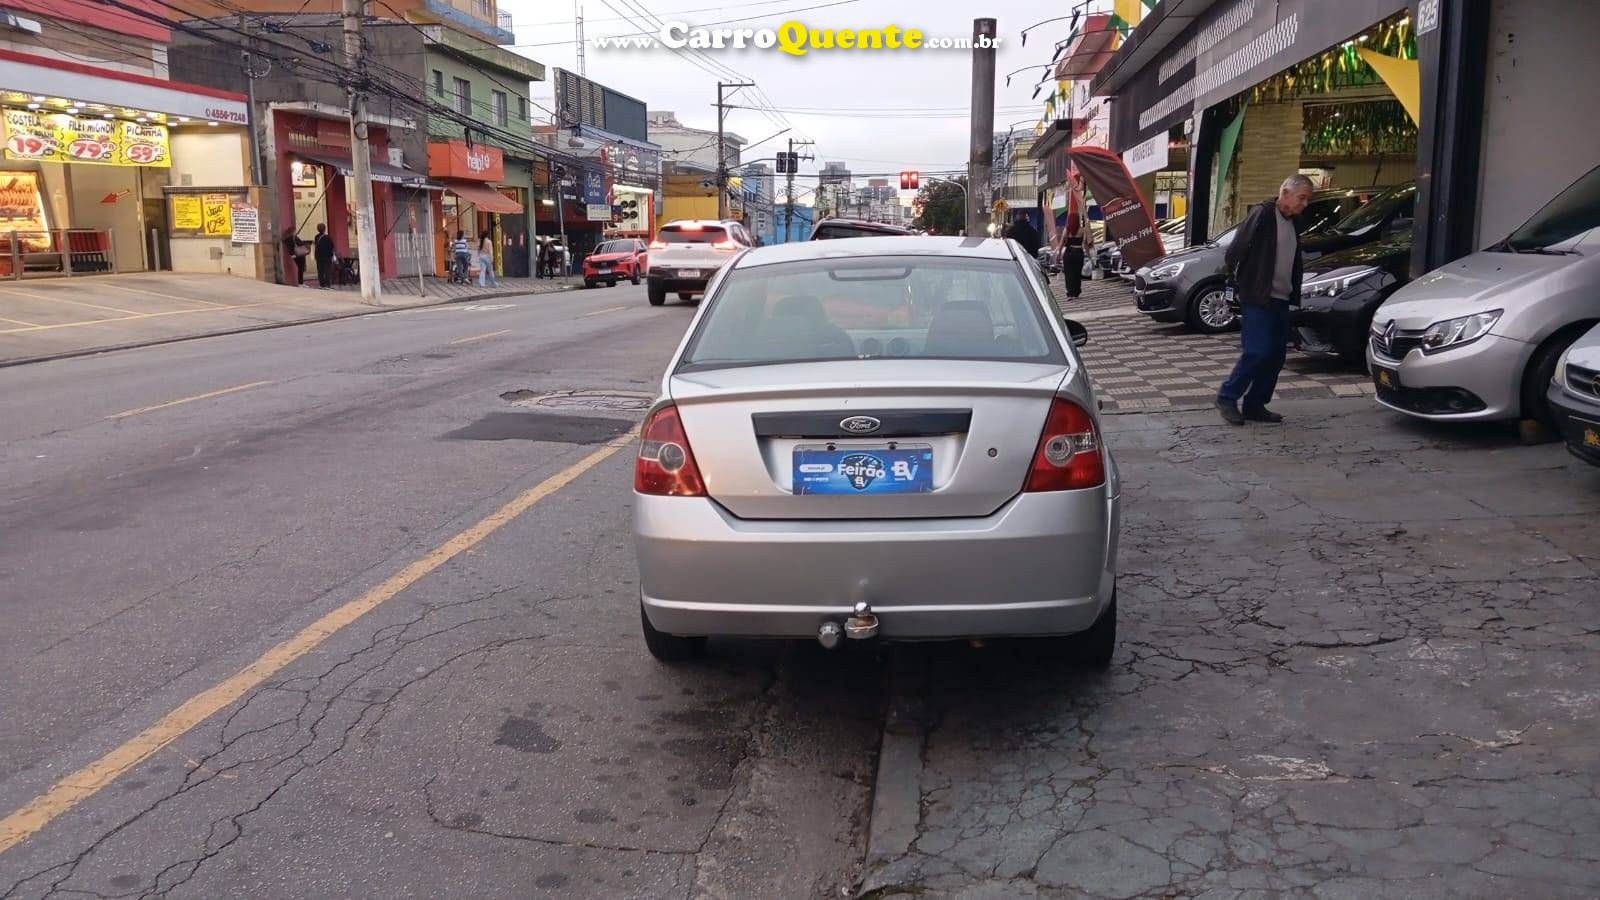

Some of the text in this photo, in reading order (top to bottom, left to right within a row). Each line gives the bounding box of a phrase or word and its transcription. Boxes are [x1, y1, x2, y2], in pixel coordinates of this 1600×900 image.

[14, 137, 43, 154] 19
[73, 143, 101, 157] 79
[131, 146, 153, 161] 59
[850, 420, 872, 429] Ford
[837, 462, 886, 480] Feirão
[893, 460, 919, 481] BV
